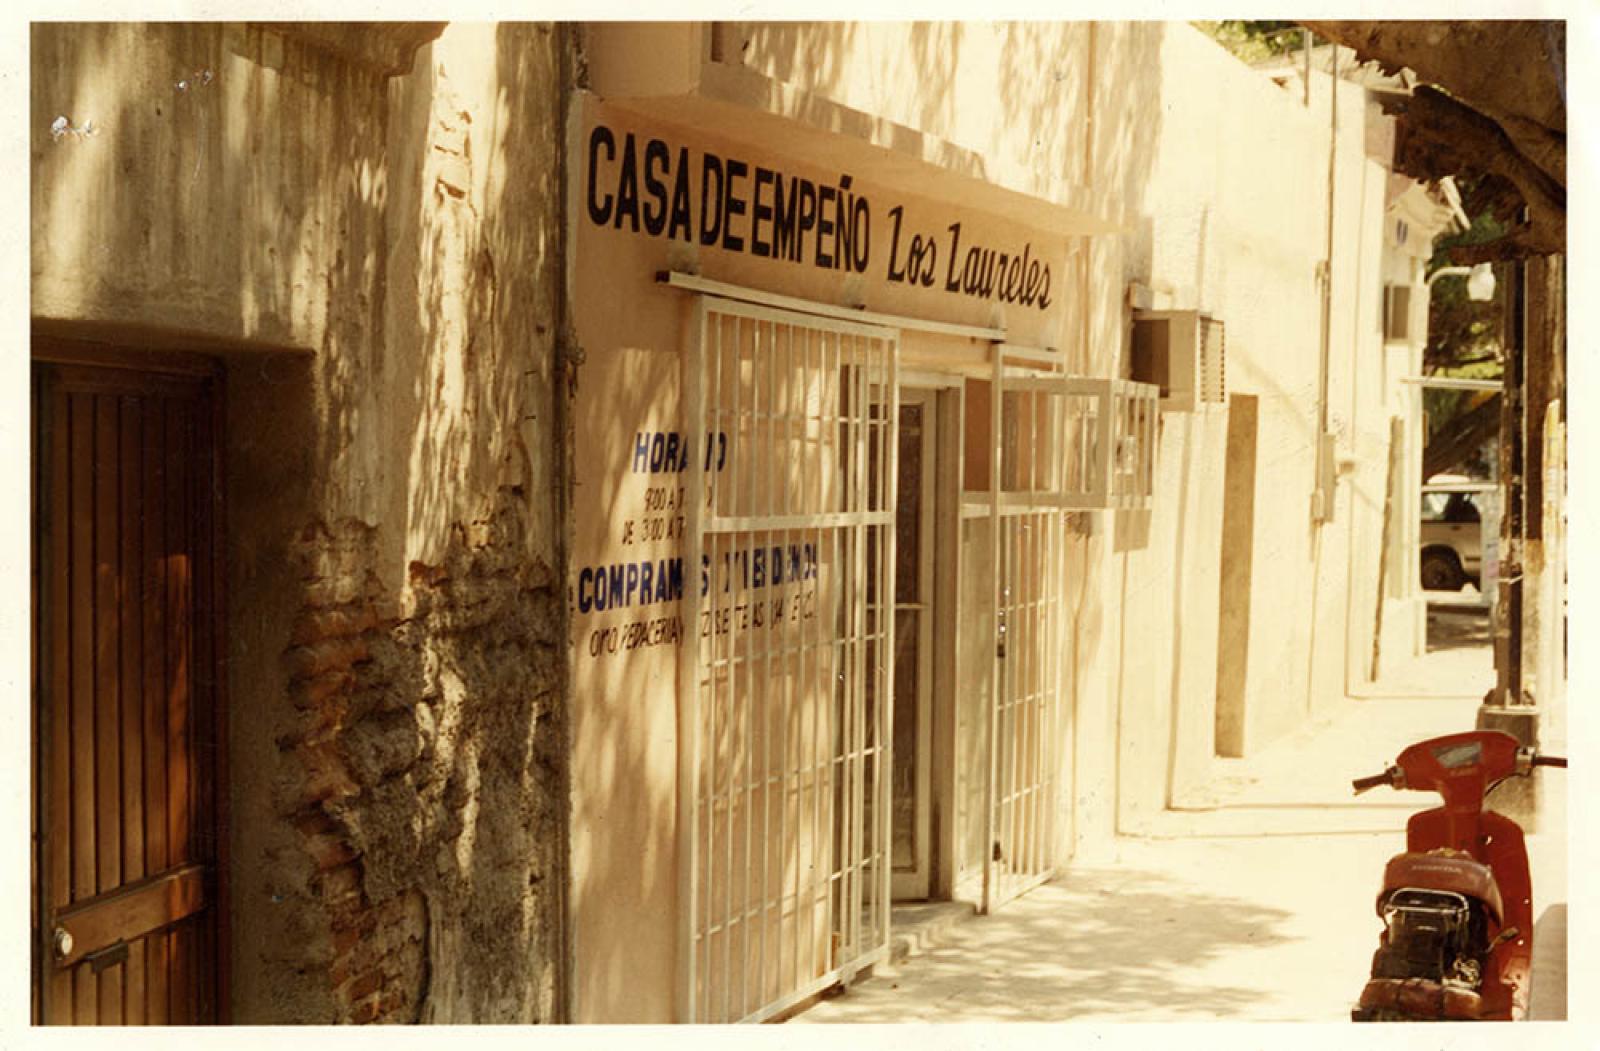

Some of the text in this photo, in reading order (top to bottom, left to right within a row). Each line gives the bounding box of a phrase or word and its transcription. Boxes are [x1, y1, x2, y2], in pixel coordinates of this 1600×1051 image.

[587, 125, 1053, 310] CASA DE EMPEÑO Los Laureles
[633, 431, 727, 474] HORAIO
[578, 553, 709, 615] COMPRAMS
